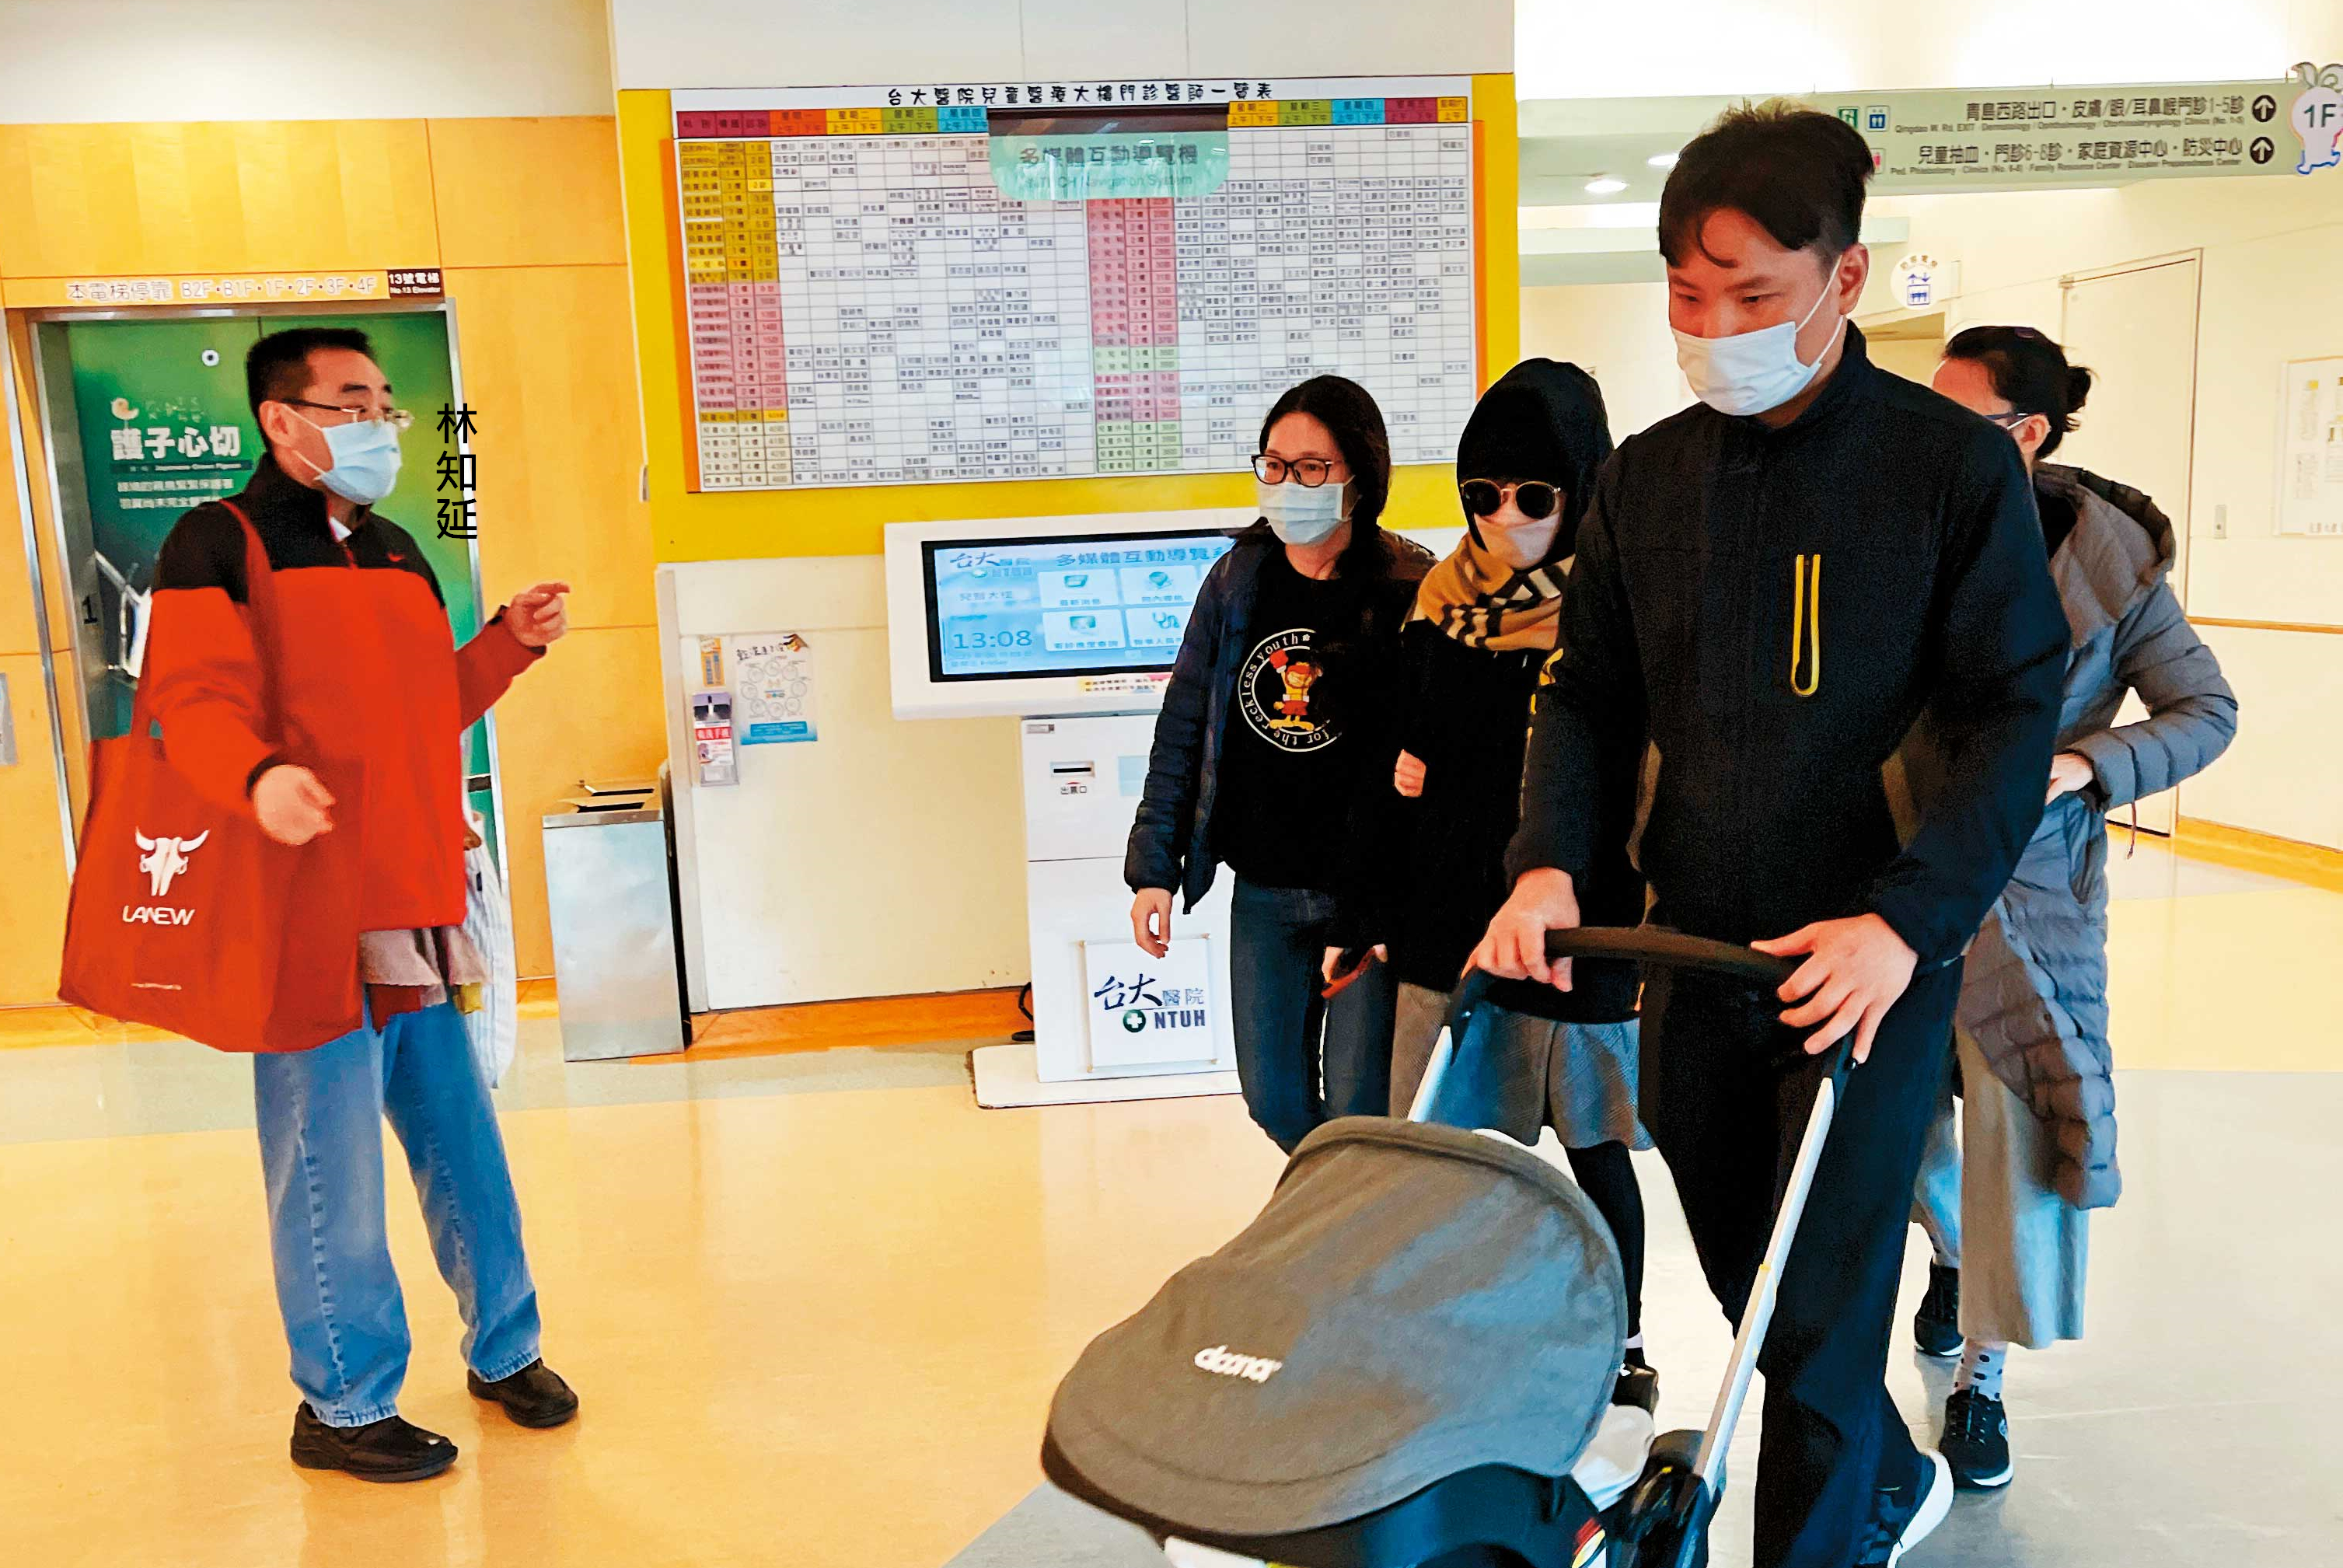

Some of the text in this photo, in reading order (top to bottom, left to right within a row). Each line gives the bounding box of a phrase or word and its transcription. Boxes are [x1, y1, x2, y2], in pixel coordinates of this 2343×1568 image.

[2303, 103, 2337, 128] 1F
[67, 281, 172, 301] 本電梯停靠
[110, 425, 242, 461] 護子心切
[82, 595, 99, 624] 1
[953, 630, 1033, 649] 13:08
[1256, 633, 1299, 662] youth
[1241, 663, 1270, 729] reckless
[1273, 729, 1297, 746] the
[1154, 1009, 1206, 1030] NTUH
